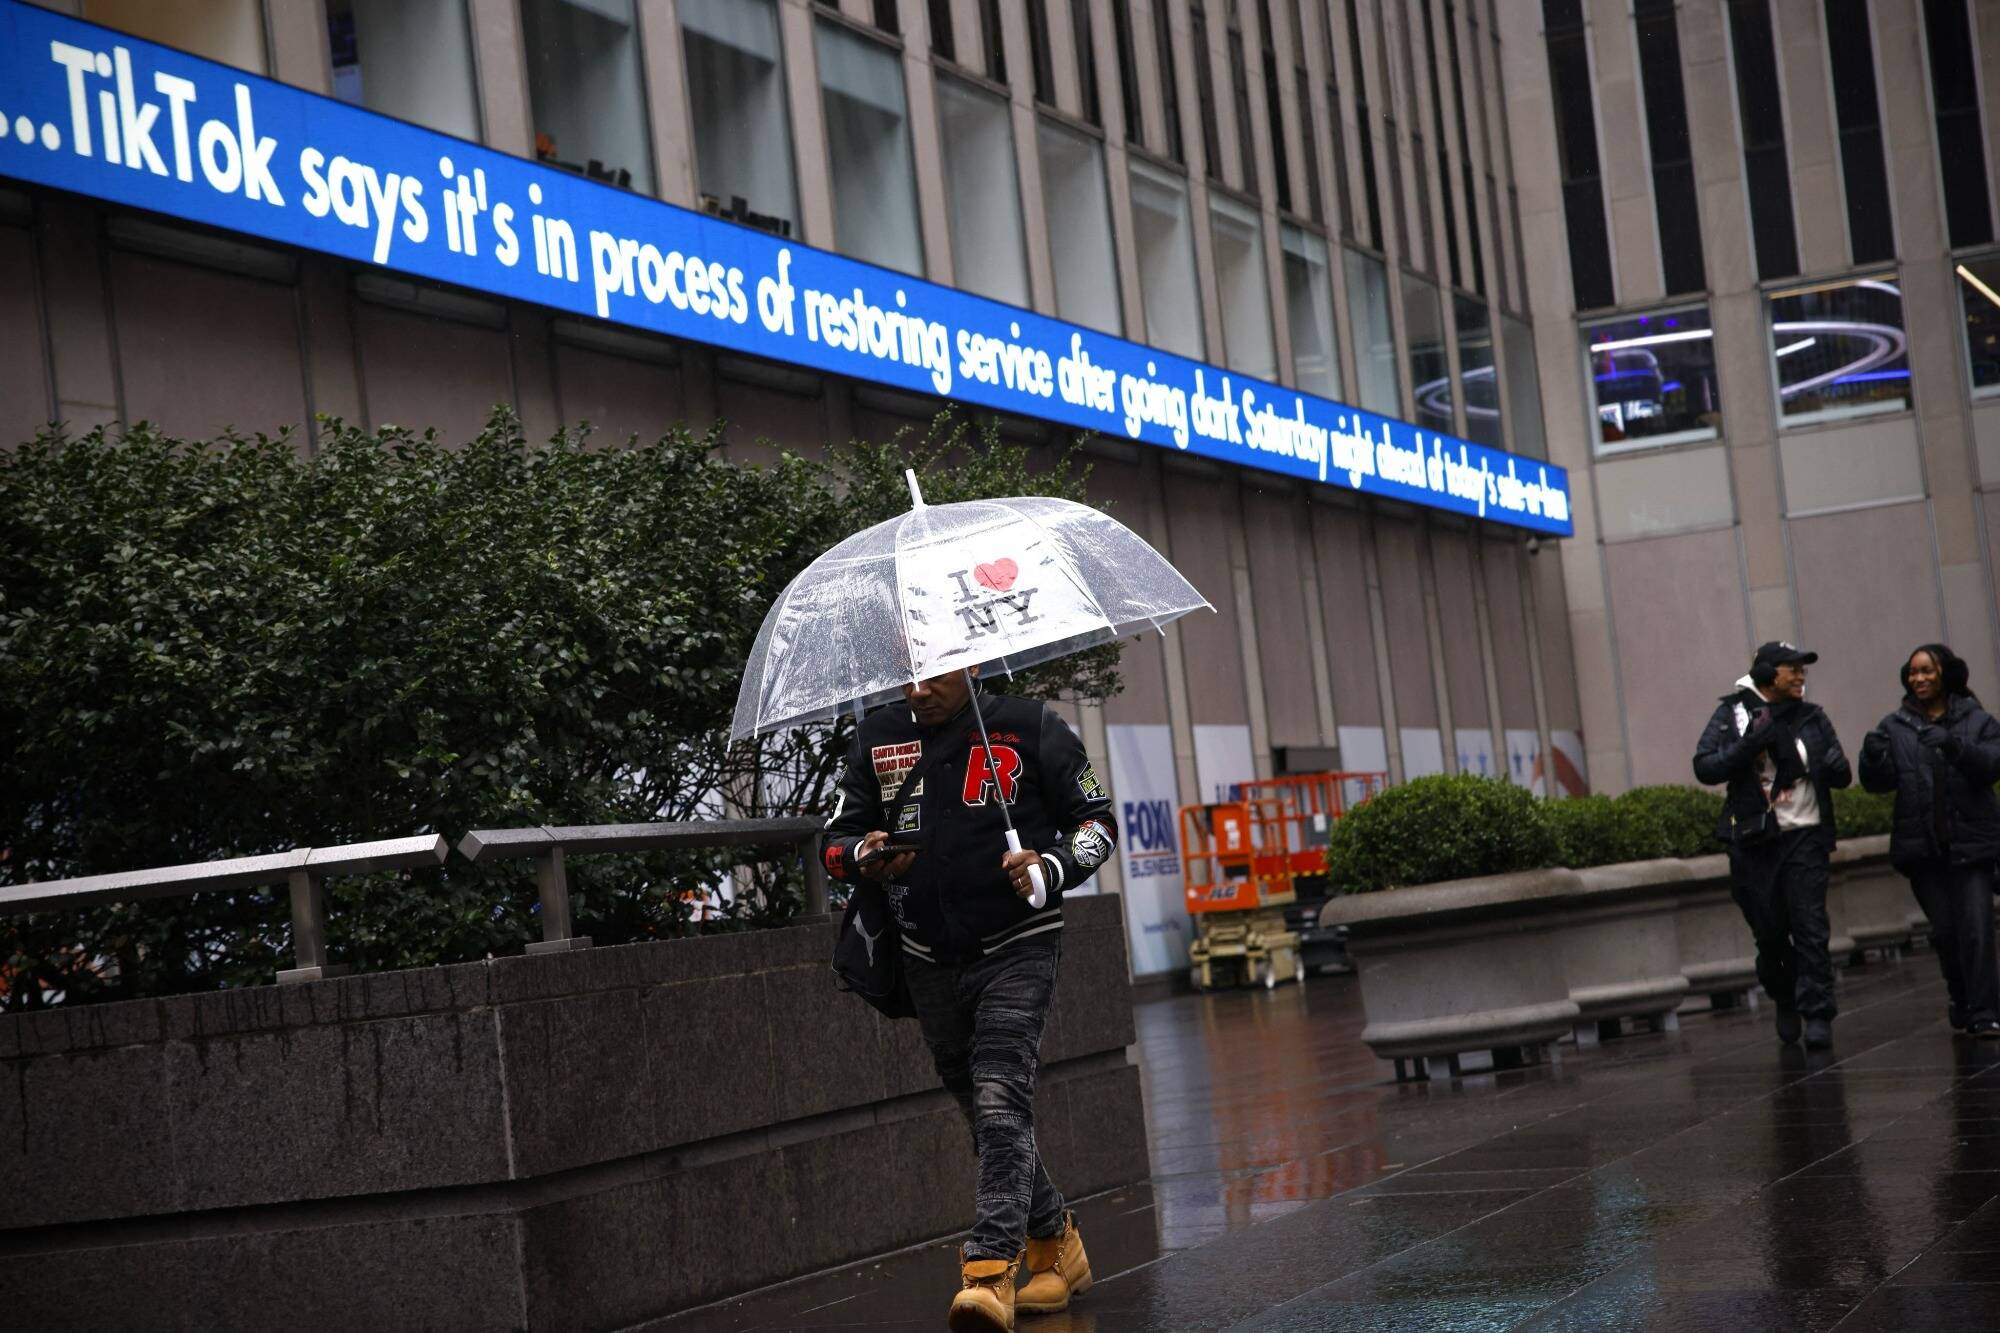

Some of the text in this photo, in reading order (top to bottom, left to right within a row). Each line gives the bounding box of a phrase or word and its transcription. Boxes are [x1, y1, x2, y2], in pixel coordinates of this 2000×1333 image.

[301, 147, 428, 265] says
[440, 157, 519, 266] it's
[529, 184, 578, 282] in
[590, 230, 748, 323] process
[757, 249, 795, 335] of
[804, 289, 951, 395] restoring
[957, 323, 1053, 398] service
[1058, 333, 1116, 412] after
[1121, 362, 1188, 449] going
[1191, 369, 1242, 444] dark
[1243, 389, 1327, 481] Saturday
[1331, 415, 1375, 488] night
[1376, 424, 1427, 488] ahead
[1427, 438, 1445, 491] of
[1445, 446, 1497, 516] today's
[947, 569, 979, 603] I
[954, 587, 1038, 641] NY
[962, 745, 1023, 807] R
[1124, 800, 1172, 852] FOX
